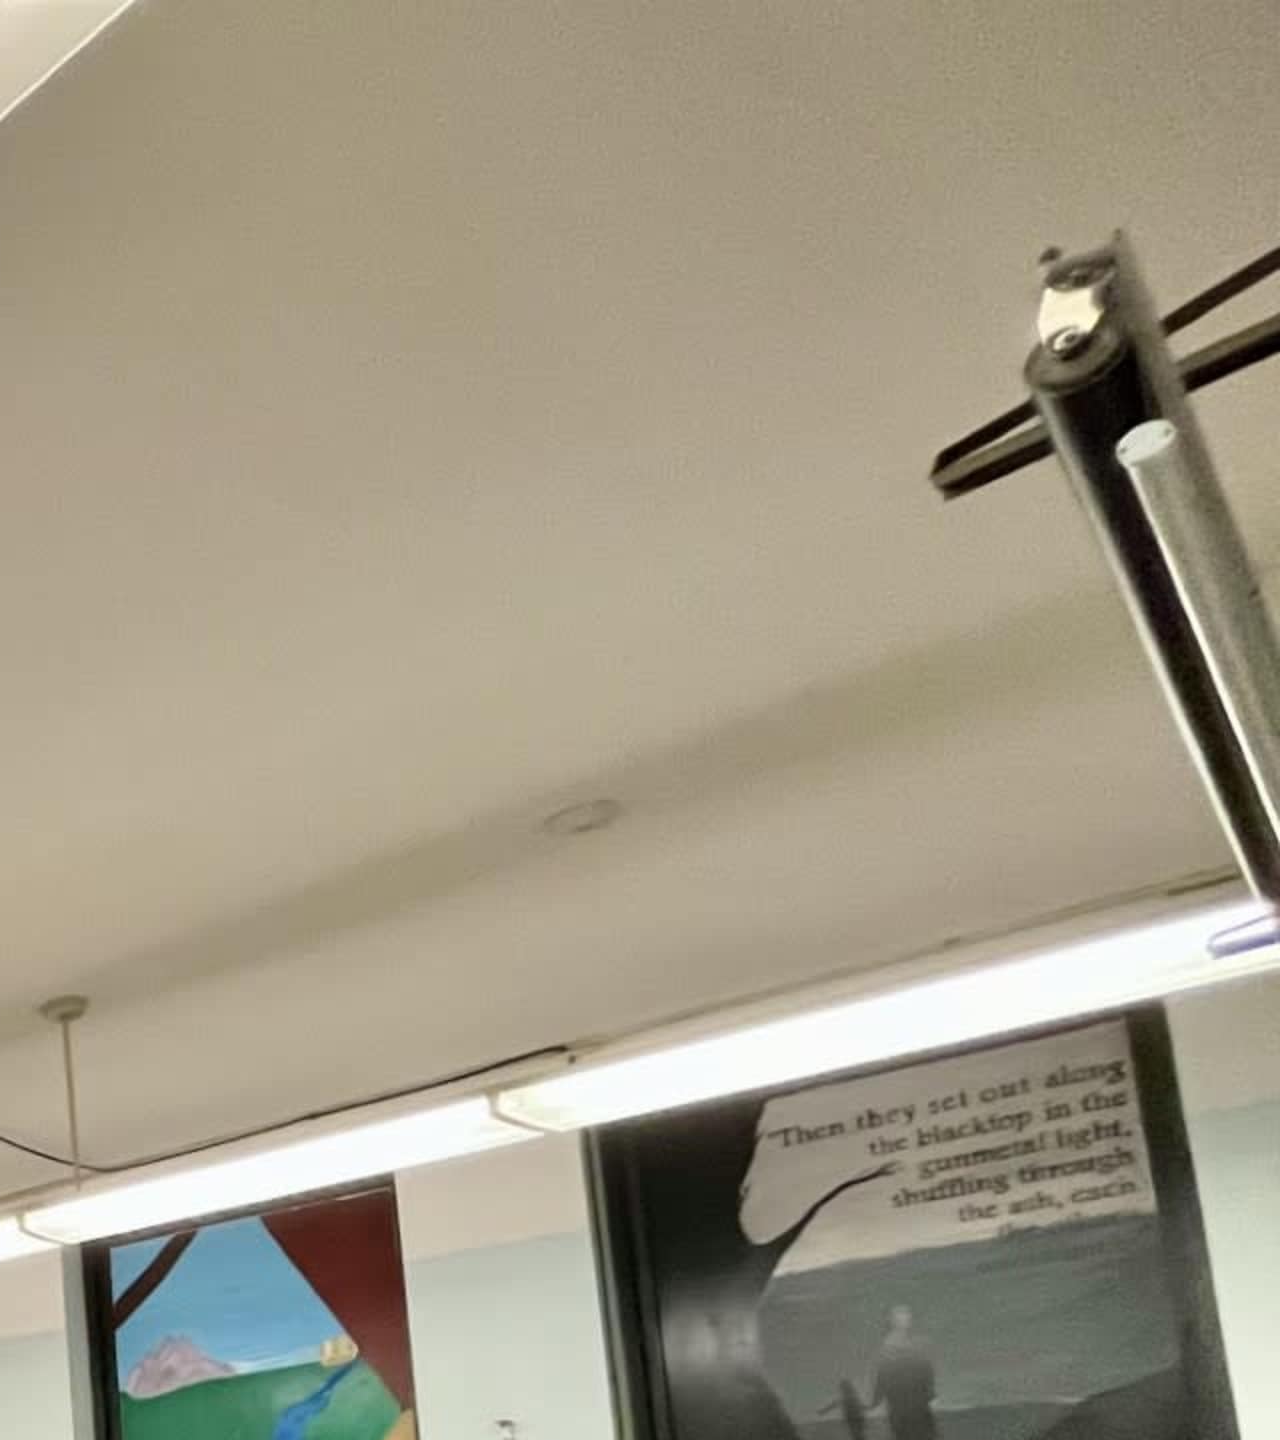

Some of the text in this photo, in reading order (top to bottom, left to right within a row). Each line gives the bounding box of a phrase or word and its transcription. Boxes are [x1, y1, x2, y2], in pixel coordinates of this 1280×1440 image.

[856, 1102, 916, 1130] they
[928, 1093, 969, 1115] set
[980, 1077, 1030, 1103] out
[1045, 1059, 1126, 1088] along
[869, 1089, 1129, 1156] the blacktop in the
[891, 1146, 1135, 1209] shuffling through
[918, 1131, 1046, 1180] gunmetal
[959, 1201, 998, 1222] the
[1070, 1177, 1136, 1204] each
